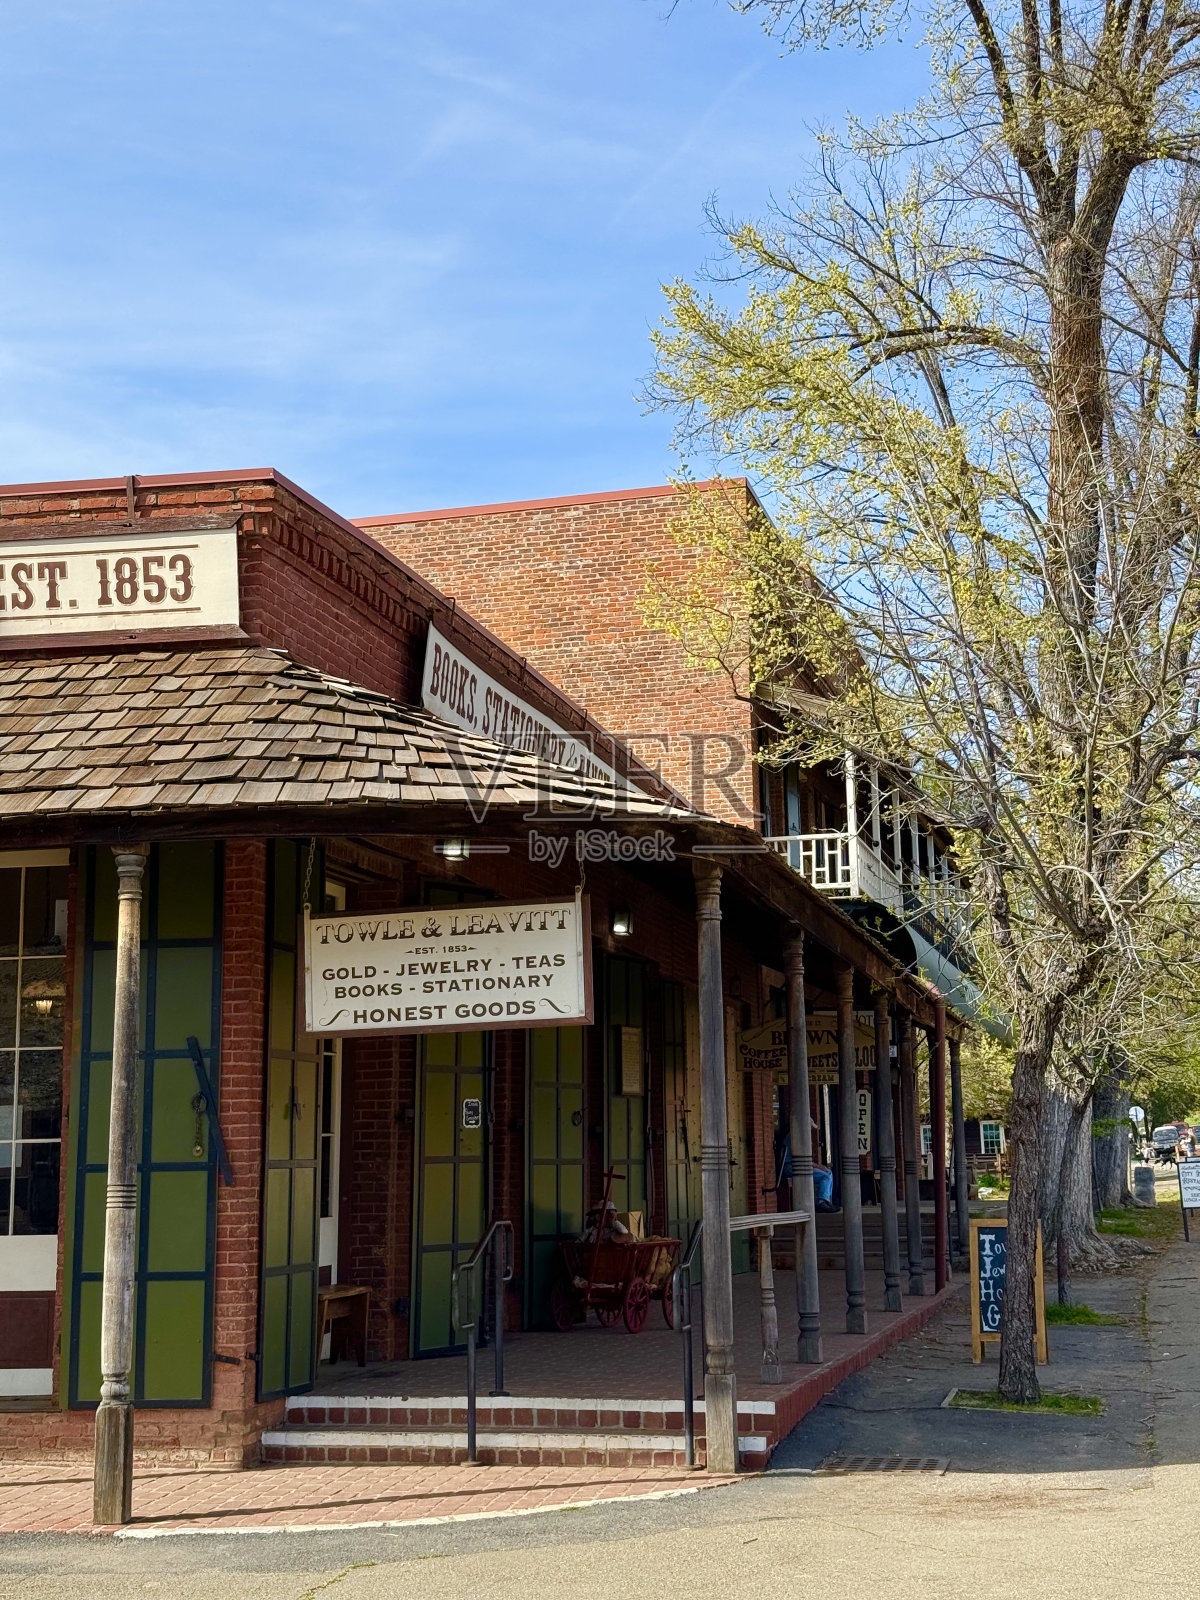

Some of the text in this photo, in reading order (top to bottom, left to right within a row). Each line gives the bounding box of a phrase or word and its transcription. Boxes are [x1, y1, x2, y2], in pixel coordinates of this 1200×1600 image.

[0, 554, 193, 609] ST. 1853
[430, 642, 477, 729] BOOKS,
[316, 909, 571, 944] TOWLE & LEAVITT
[415, 945, 467, 955] EST. 1853
[322, 965, 377, 981] GOLD
[396, 958, 492, 977] JEWELRY
[512, 954, 566, 970] TEAS
[334, 983, 402, 999] BOOKS
[422, 974, 554, 993] STATIONARY
[353, 1001, 536, 1024] HONEST GOODS
[739, 1044, 787, 1059] COFFEE
[744, 1058, 782, 1069] HOUSE
[858, 1093, 868, 1150] OPEN
